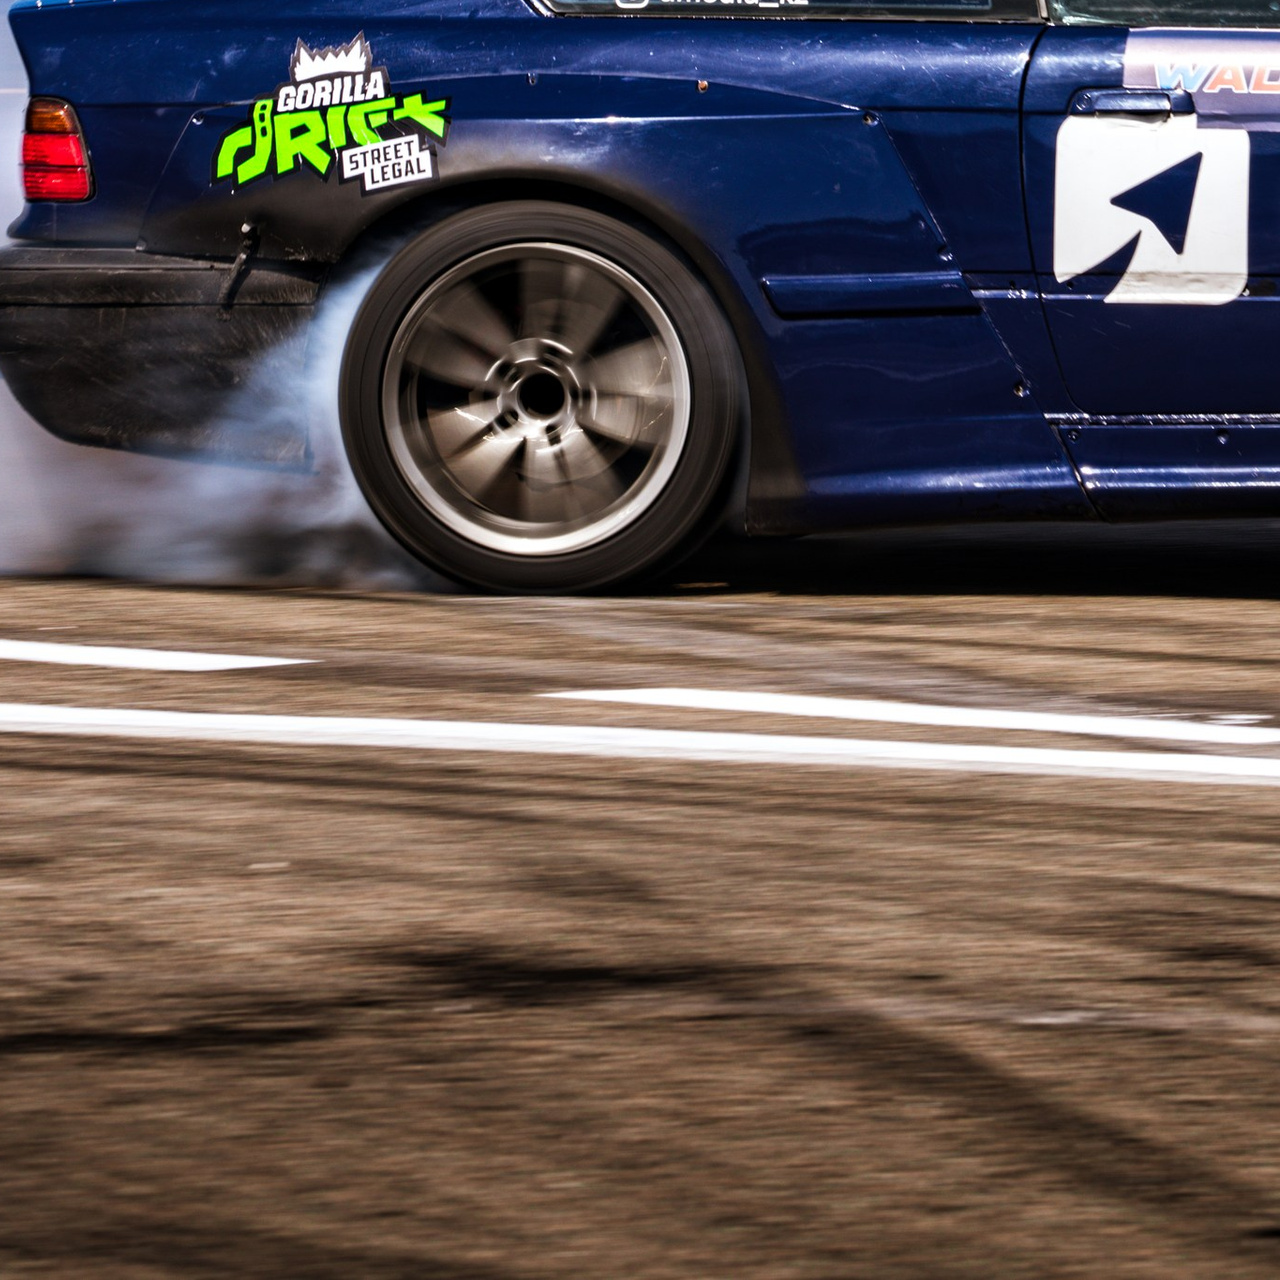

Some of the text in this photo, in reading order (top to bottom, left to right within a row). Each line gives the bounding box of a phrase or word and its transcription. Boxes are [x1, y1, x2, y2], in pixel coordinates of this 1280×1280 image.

[277, 71, 385, 112] GORILLA
[349, 140, 415, 171] STREET
[370, 157, 427, 185] LEGAL
